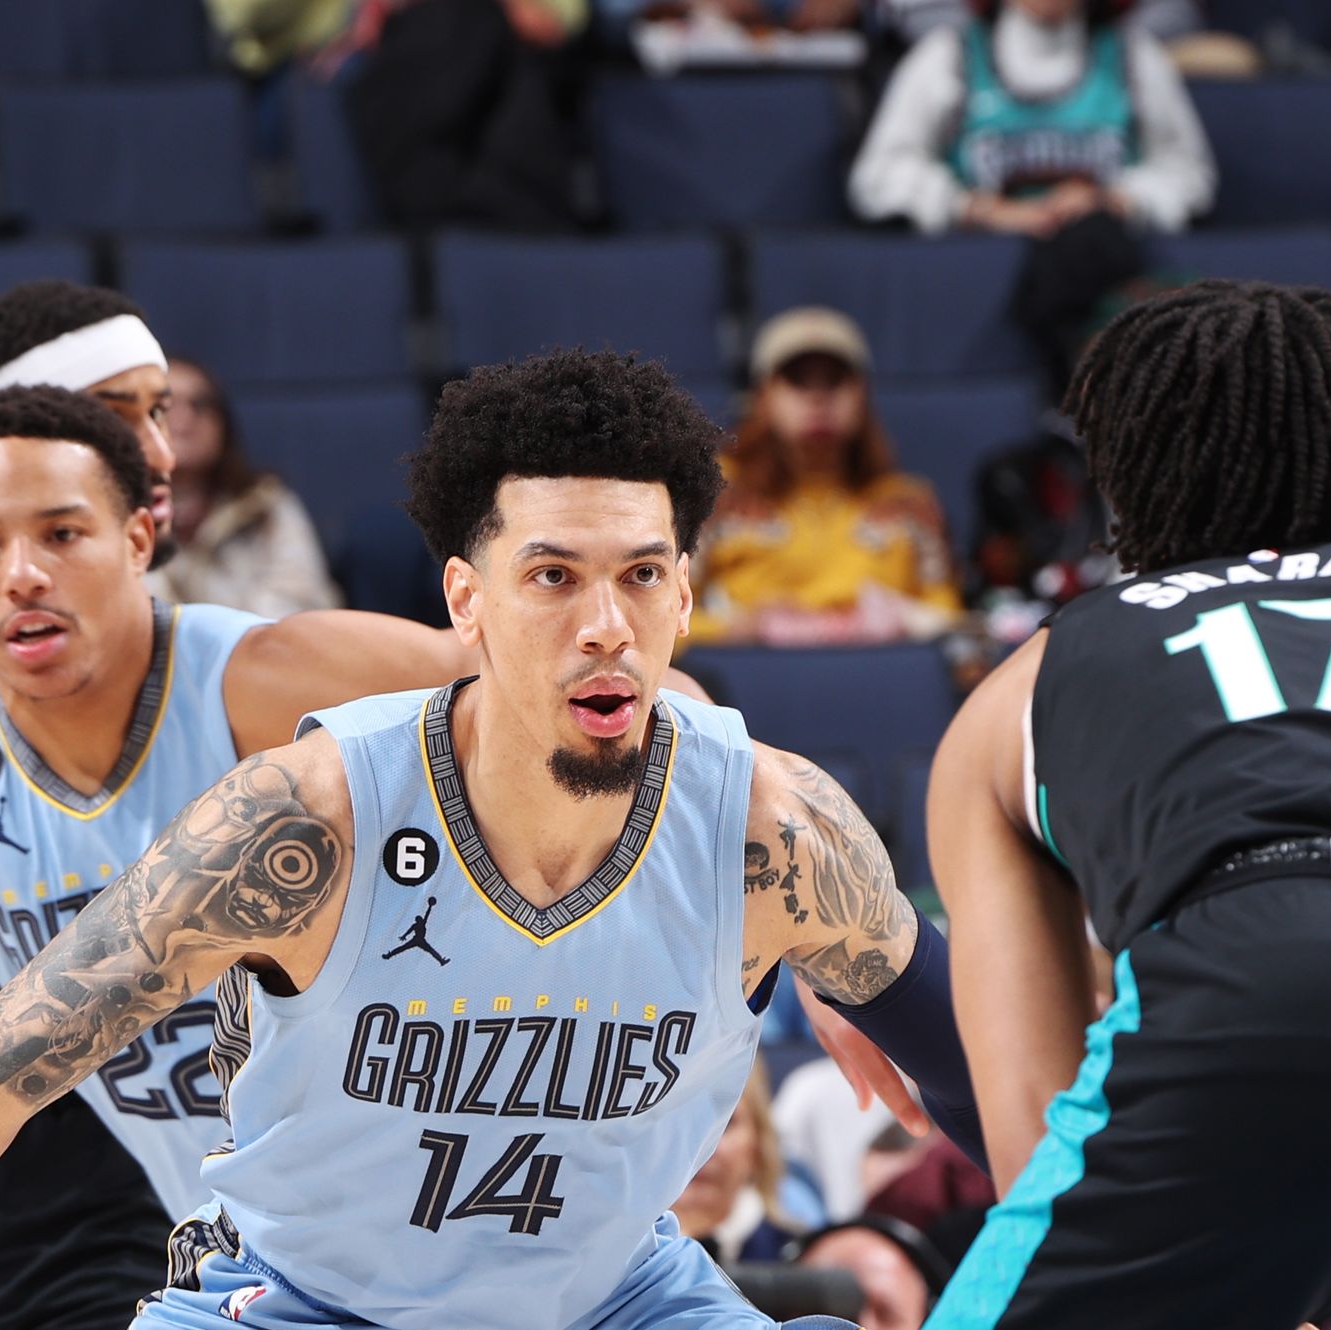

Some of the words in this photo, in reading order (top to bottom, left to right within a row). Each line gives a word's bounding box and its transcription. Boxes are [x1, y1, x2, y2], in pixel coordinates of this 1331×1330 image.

[396, 836, 426, 879] 6
[97, 1000, 222, 1120] 22
[342, 1002, 697, 1122] GRIZZLIES
[407, 994, 659, 1022] MEMPHIS
[409, 1128, 566, 1237] 14
